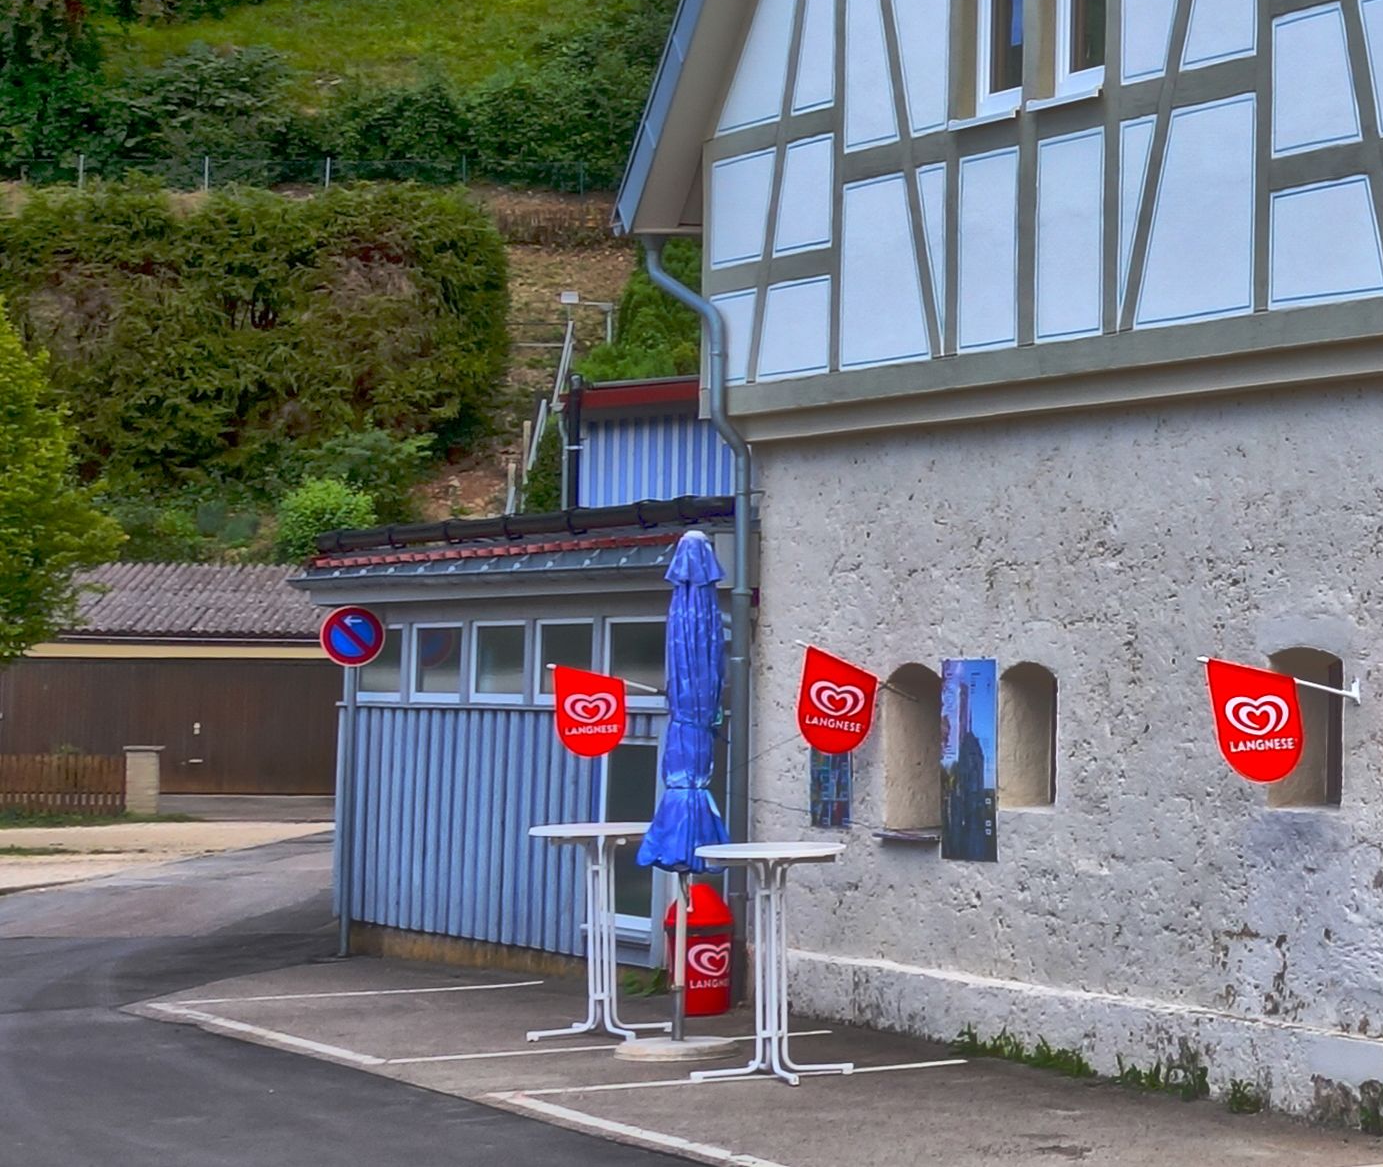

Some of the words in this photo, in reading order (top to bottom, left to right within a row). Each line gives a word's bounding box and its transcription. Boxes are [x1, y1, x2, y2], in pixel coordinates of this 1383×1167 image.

[564, 723, 619, 736] LANGNESE
[805, 714, 862, 733] LANGNESE
[1229, 737, 1296, 753] LANGNESE
